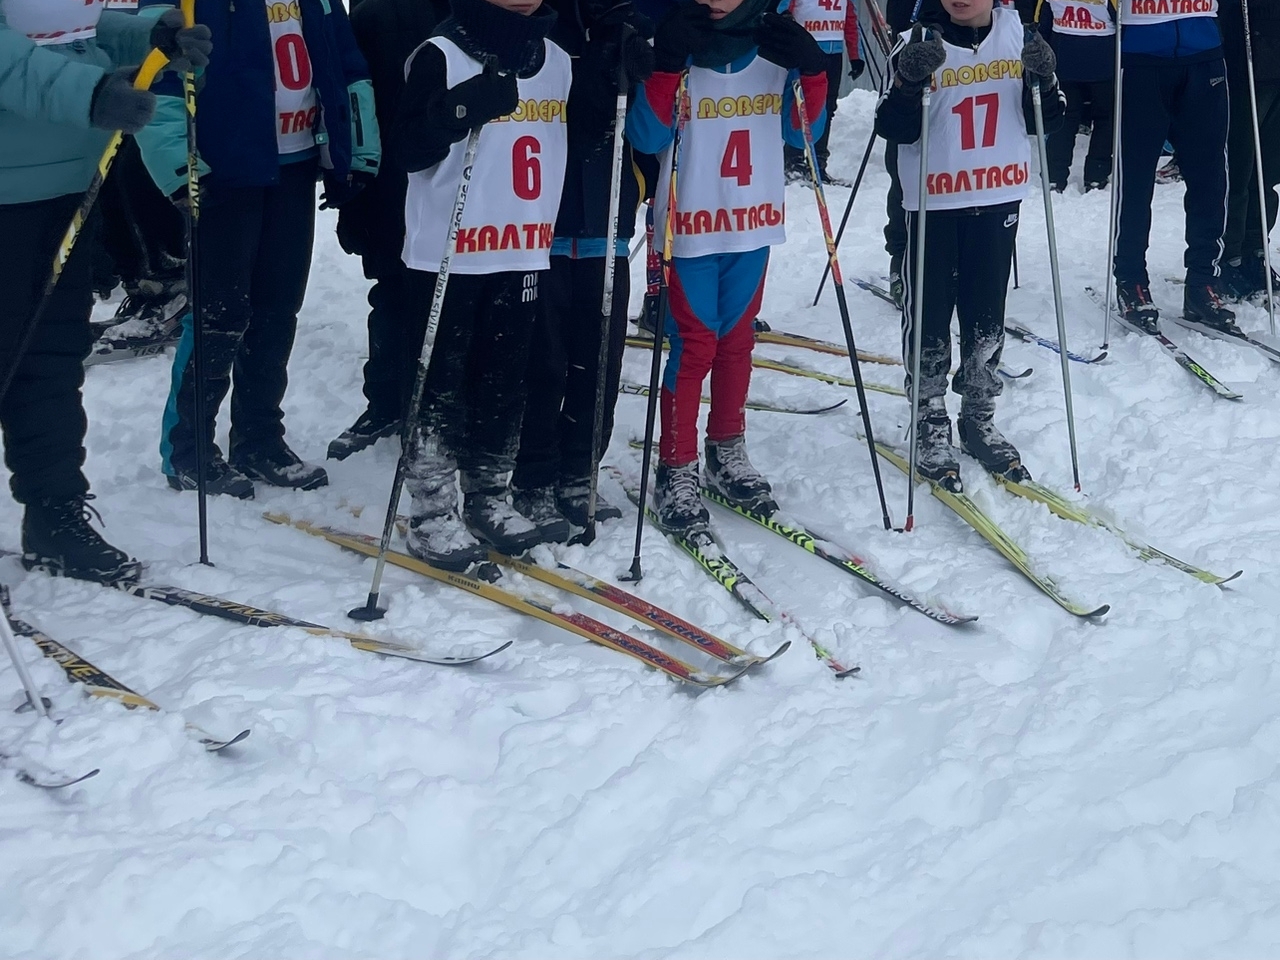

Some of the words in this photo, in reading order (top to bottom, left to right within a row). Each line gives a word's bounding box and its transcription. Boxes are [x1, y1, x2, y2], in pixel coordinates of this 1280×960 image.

[941, 60, 1023, 88] ДОВЕРИ
[488, 99, 567, 123] ОВЕР
[697, 94, 783, 119] ДОВЕРИ
[952, 93, 999, 150] 17
[512, 135, 541, 201] 6
[720, 130, 753, 186] 4
